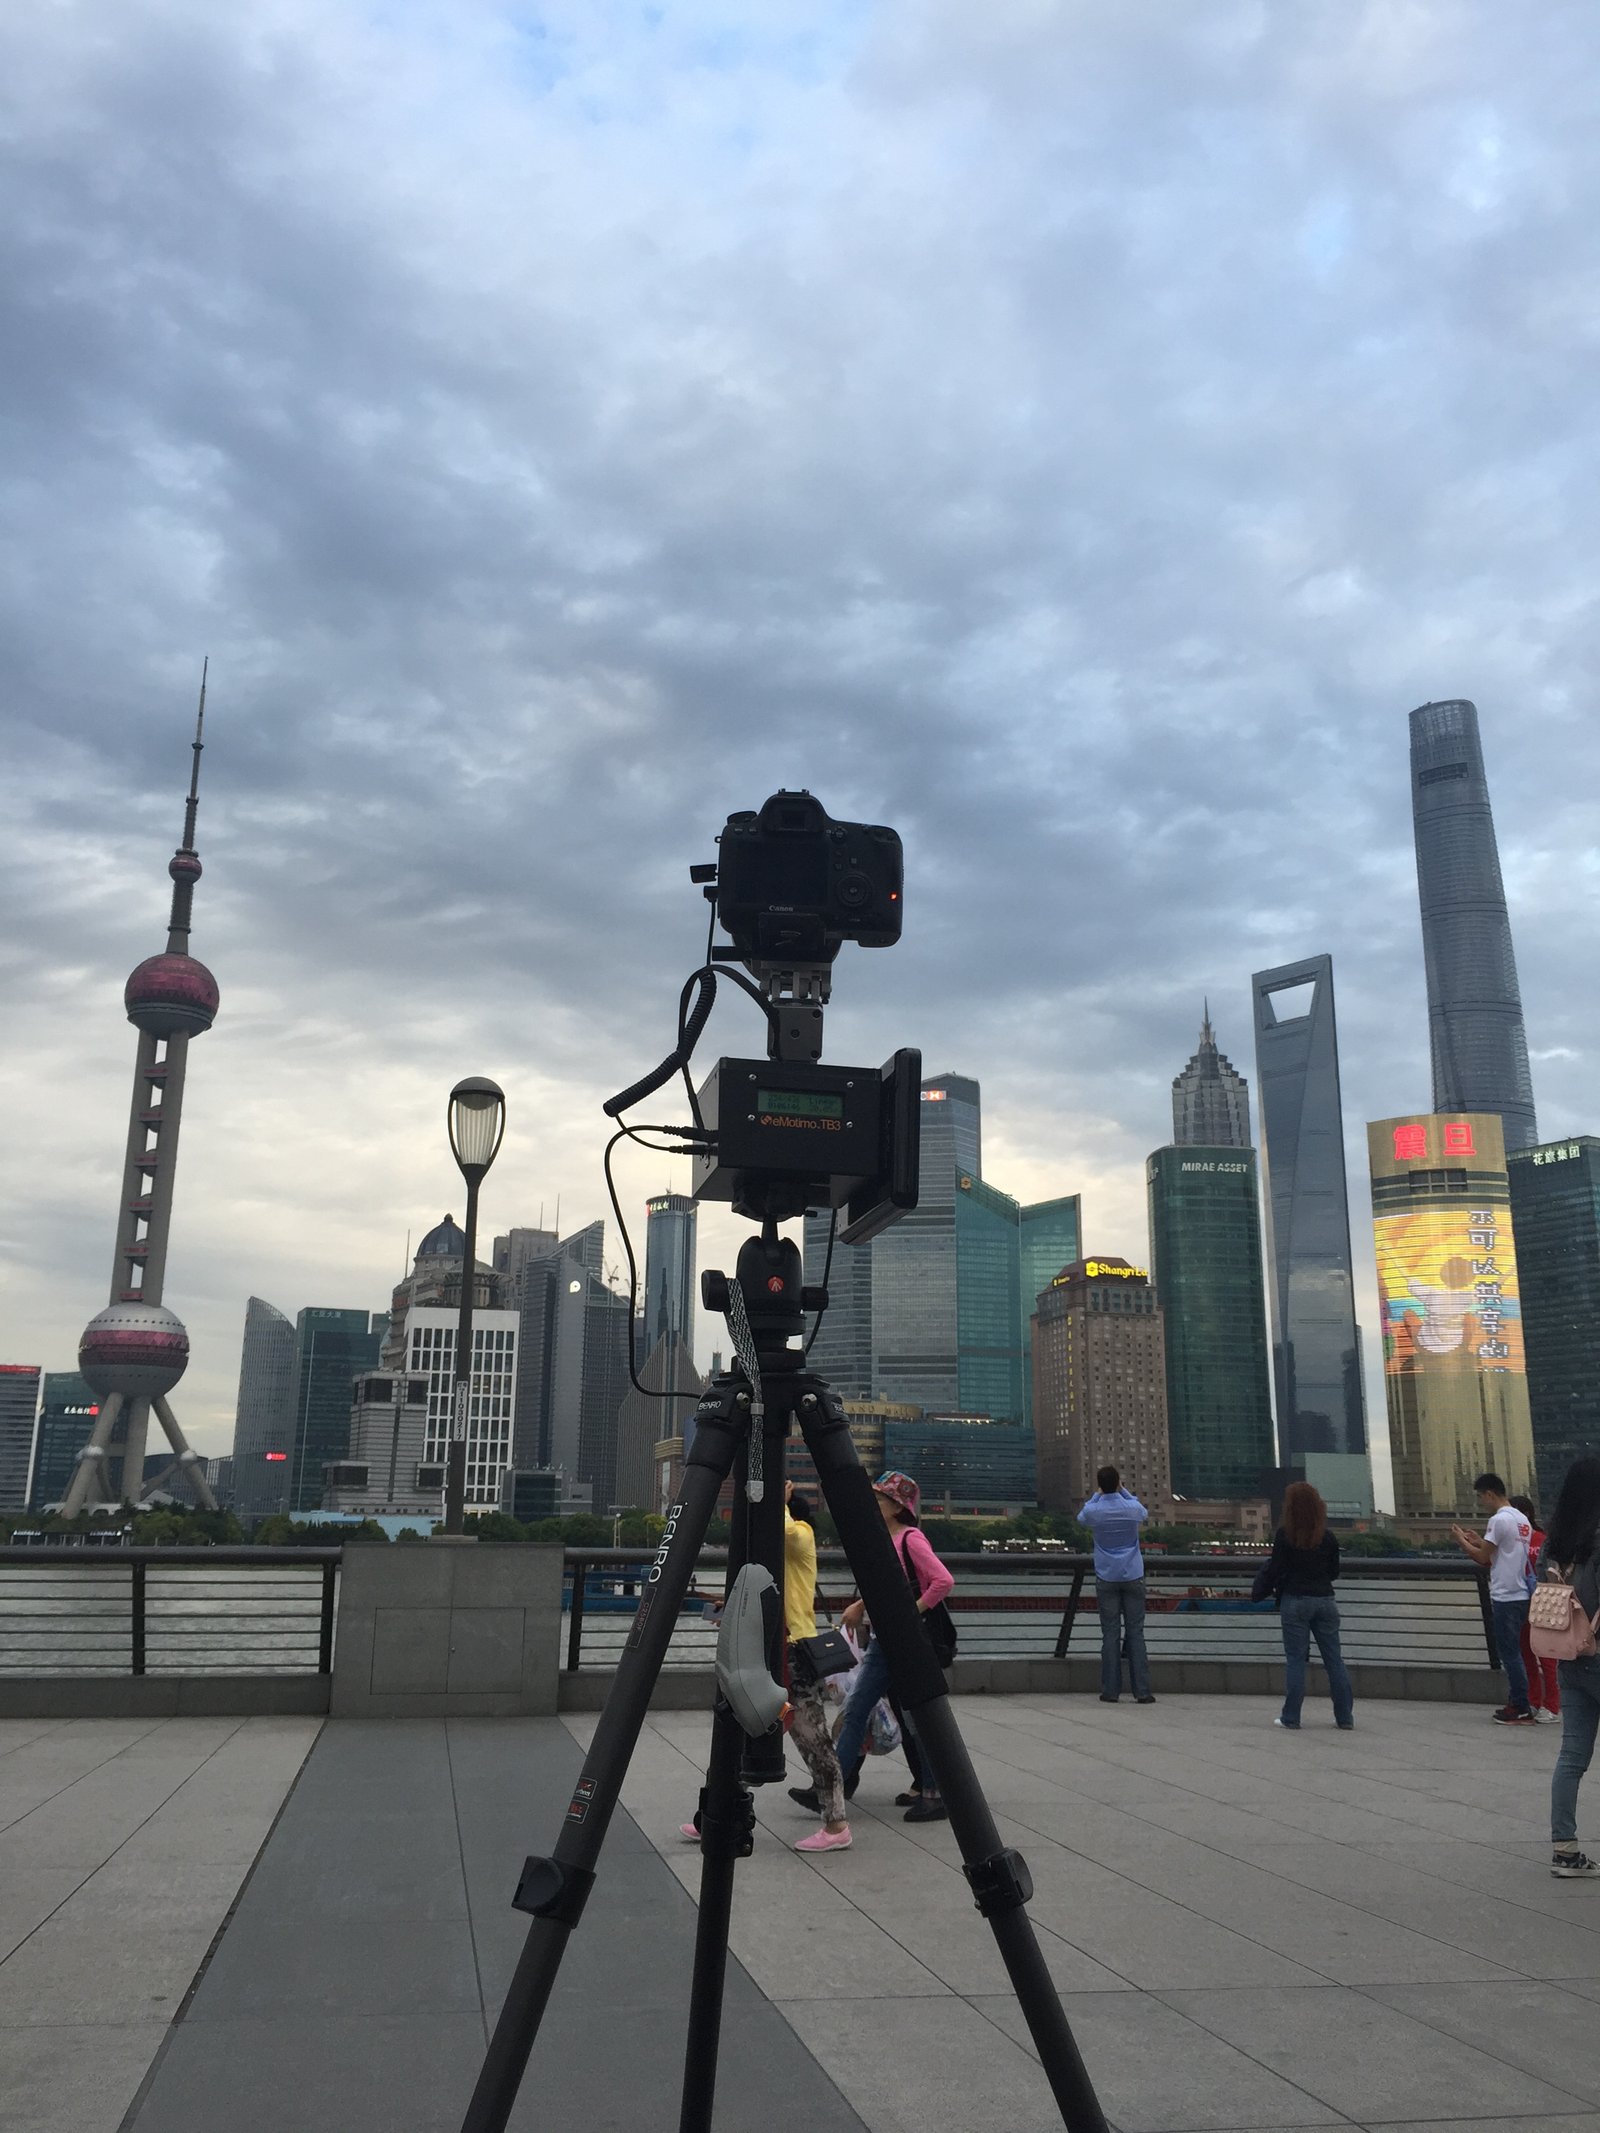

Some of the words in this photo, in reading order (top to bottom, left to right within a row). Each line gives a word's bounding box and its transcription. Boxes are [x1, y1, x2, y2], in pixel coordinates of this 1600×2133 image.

[768, 904, 794, 912] Canon
[1393, 1122, 1476, 1160] 震旦
[1532, 1145, 1580, 1166] 花旗集团
[1181, 1162, 1215, 1172] MIRAE
[1217, 1163, 1248, 1173] ASSET
[648, 1504, 683, 1583] BENRO
